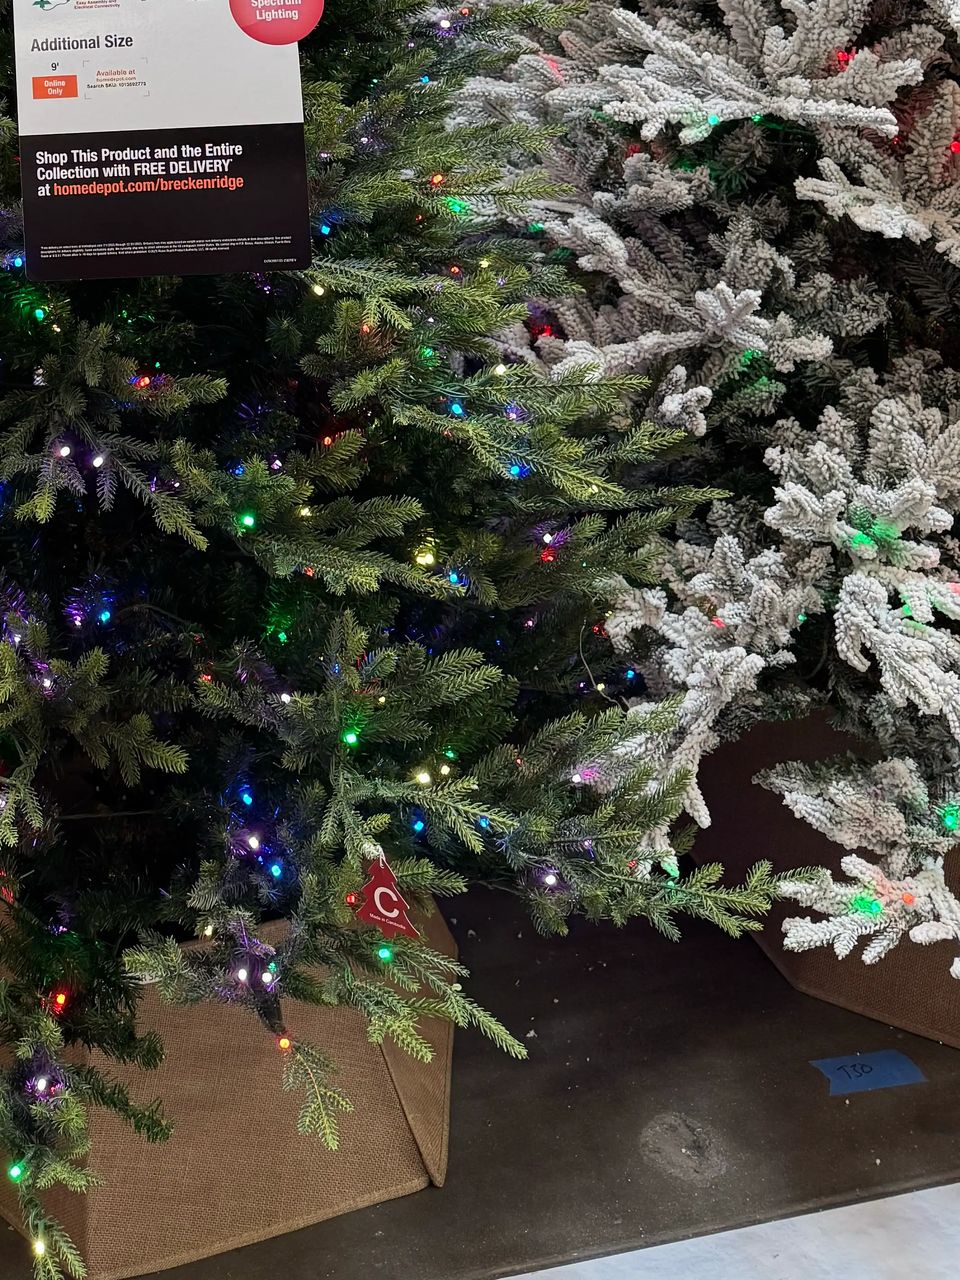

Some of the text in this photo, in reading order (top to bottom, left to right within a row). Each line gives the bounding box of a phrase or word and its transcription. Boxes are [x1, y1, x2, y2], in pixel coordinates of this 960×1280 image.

[256, 8, 299, 21] Lighting
[30, 34, 134, 52] Additional Size
[50, 62, 60, 72] 9'
[44, 79, 66, 88] Online
[47, 87, 63, 96] Only
[36, 142, 243, 166] Shop This Product and the Entire
[36, 160, 230, 181] Collection with FREE DELIVERY
[38, 176, 244, 197] at homedepot.com/breckenridge
[374, 886, 400, 918] C
[836, 1062, 873, 1080] T30
